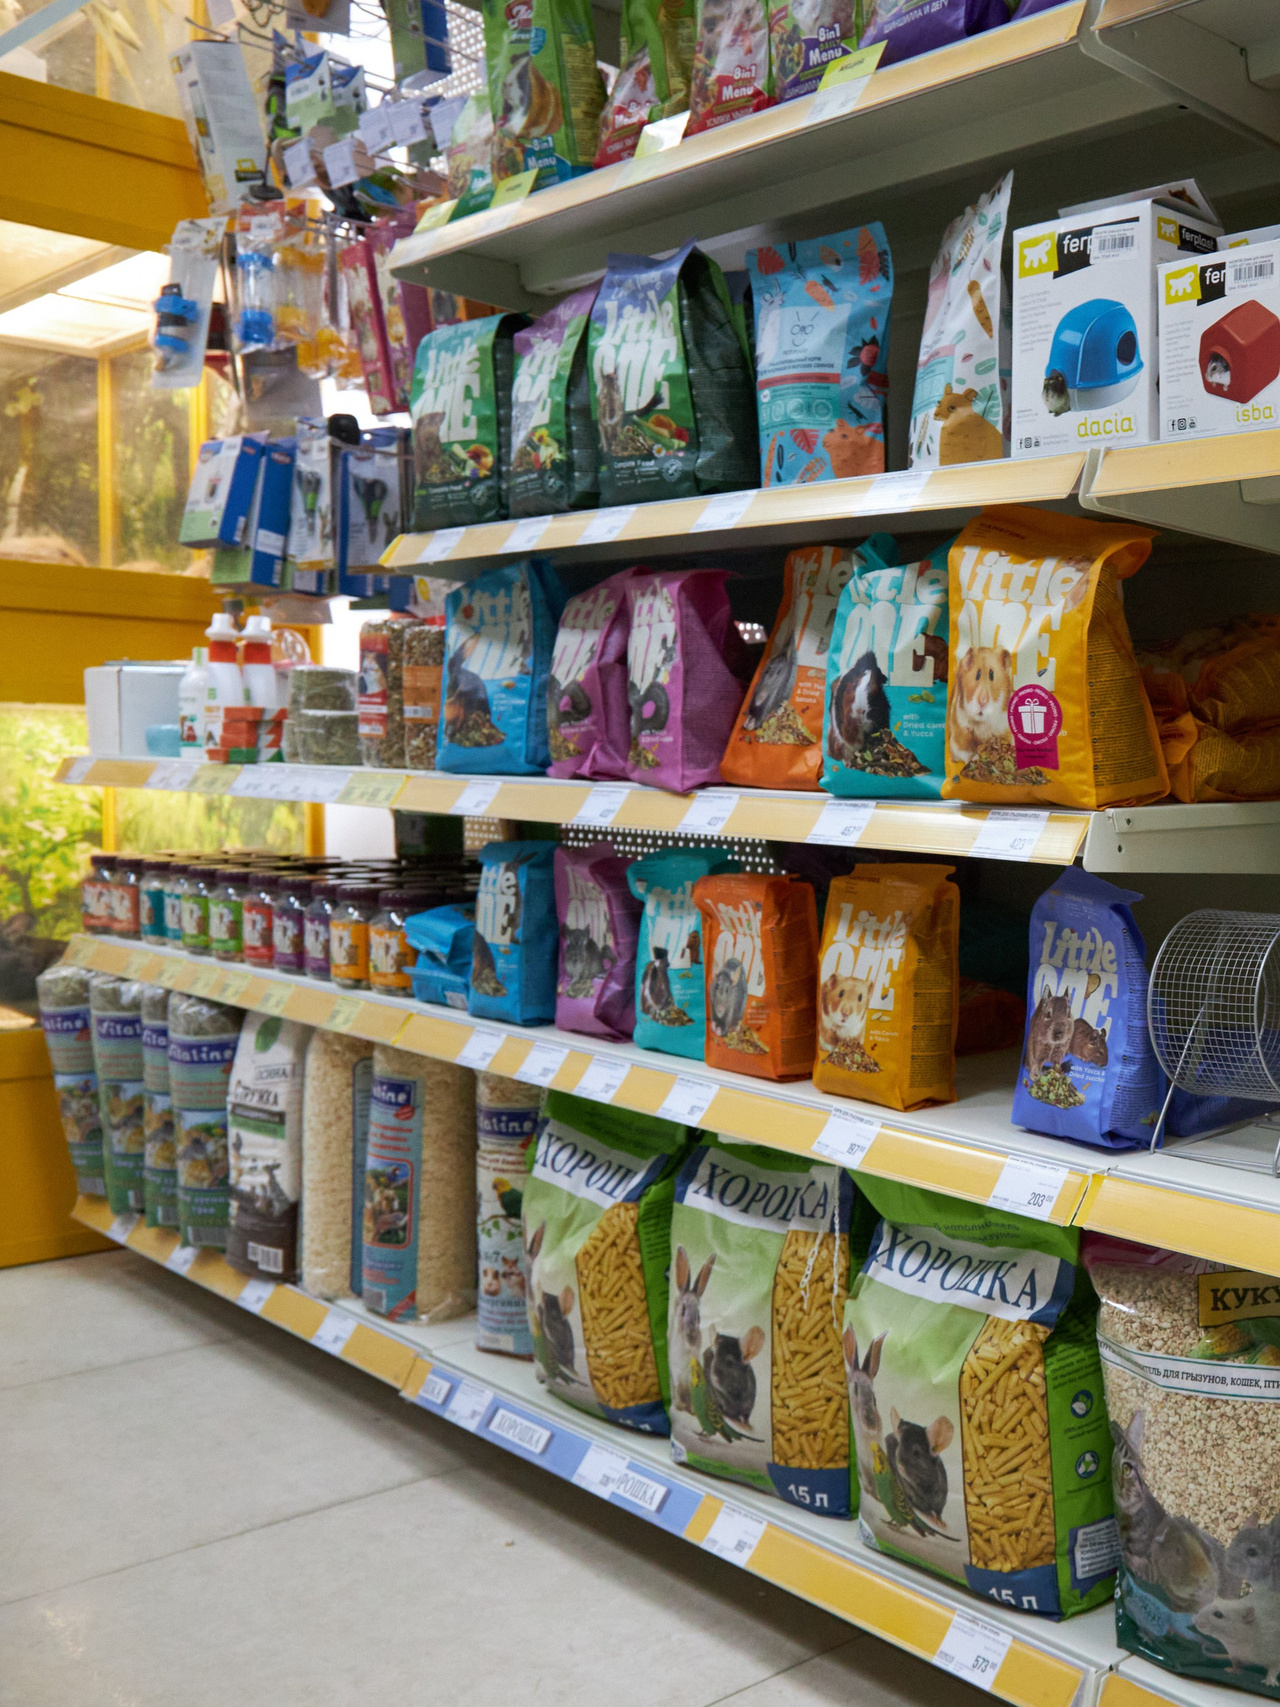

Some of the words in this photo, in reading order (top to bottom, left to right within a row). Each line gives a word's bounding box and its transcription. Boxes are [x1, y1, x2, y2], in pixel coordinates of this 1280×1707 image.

[818, 23, 842, 42] 8in1
[809, 47, 843, 66] Menu
[733, 65, 757, 80] 8in1
[722, 84, 754, 101] Menu
[1182, 228, 1215, 248] ferplast
[1236, 403, 1274, 423] isba
[1077, 413, 1134, 438] dacia
[903, 721, 925, 729] Dried
[1027, 1191, 1046, 1208] 203
[1163, 1369, 1180, 1379] ДЛЯ
[1180, 1371, 1229, 1387] ГРЫЗУНОВ,
[1230, 1377, 1262, 1389] КОШЕК,
[788, 1484, 812, 1505] 15
[971, 1655, 990, 1673] 573
